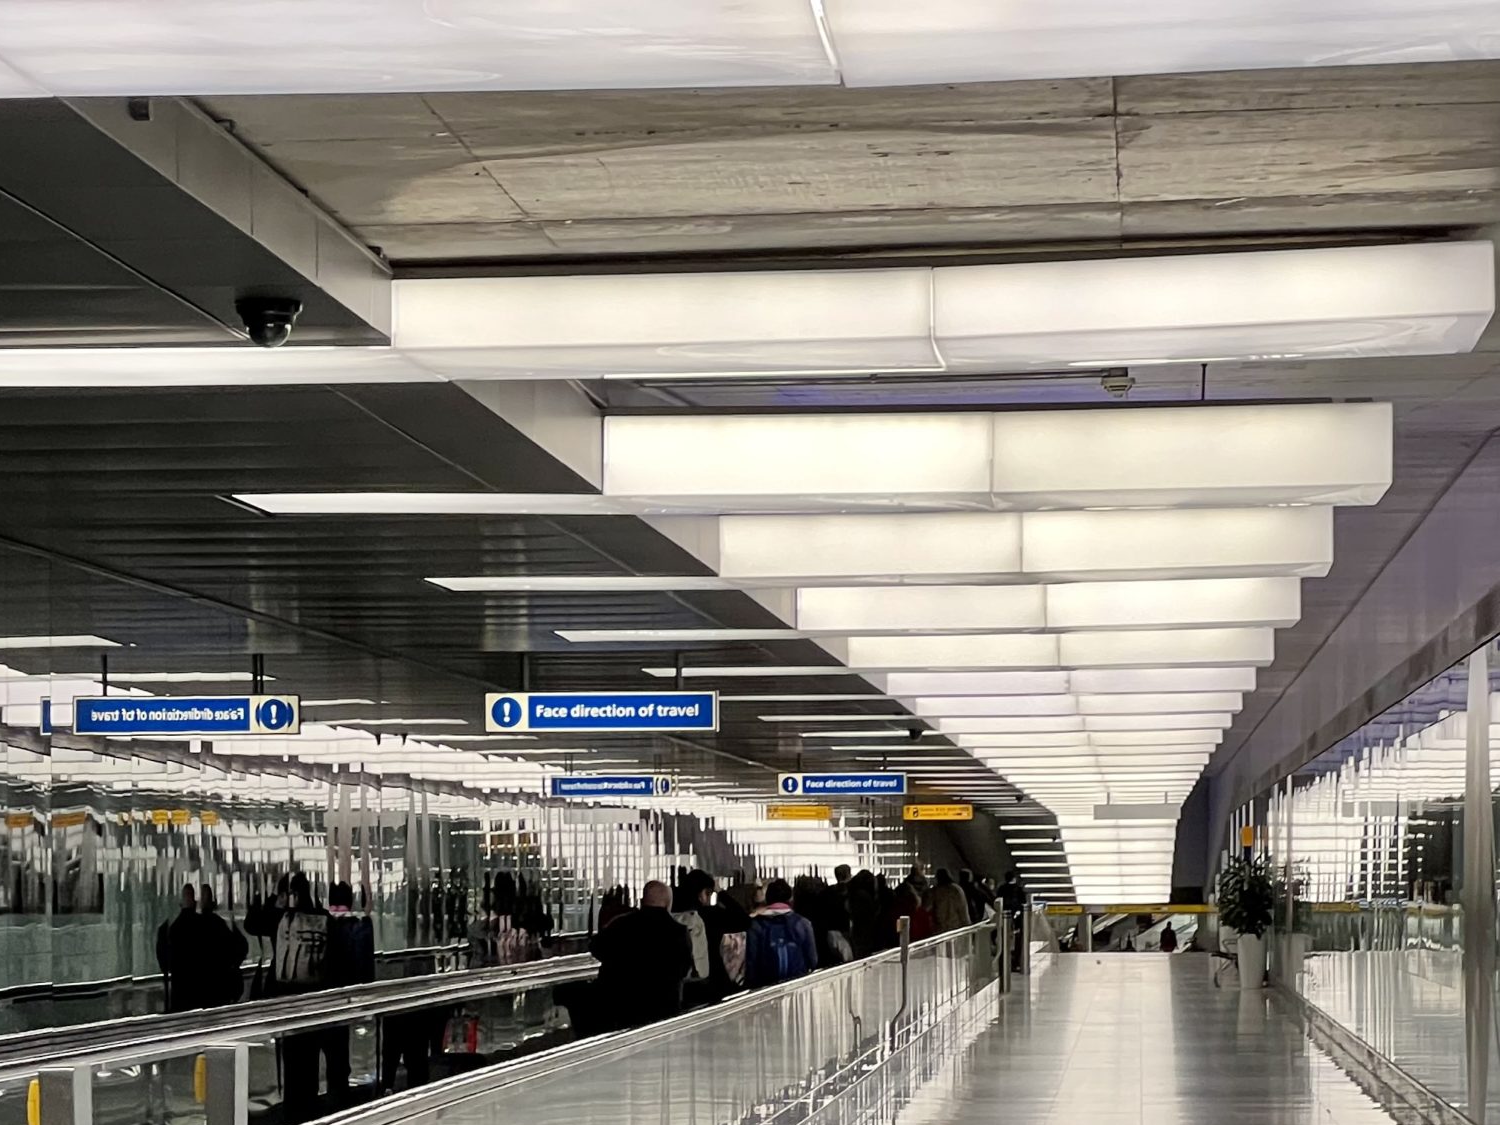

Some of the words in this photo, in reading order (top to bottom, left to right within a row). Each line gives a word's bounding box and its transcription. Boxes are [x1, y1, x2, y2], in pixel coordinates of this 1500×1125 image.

[535, 705, 568, 718] Face
[570, 704, 635, 718] direction
[638, 704, 655, 717] of
[656, 703, 699, 717] travel
[806, 779, 824, 788] Face
[825, 779, 862, 788] direction
[862, 779, 873, 788] of
[873, 779, 897, 788] travel
